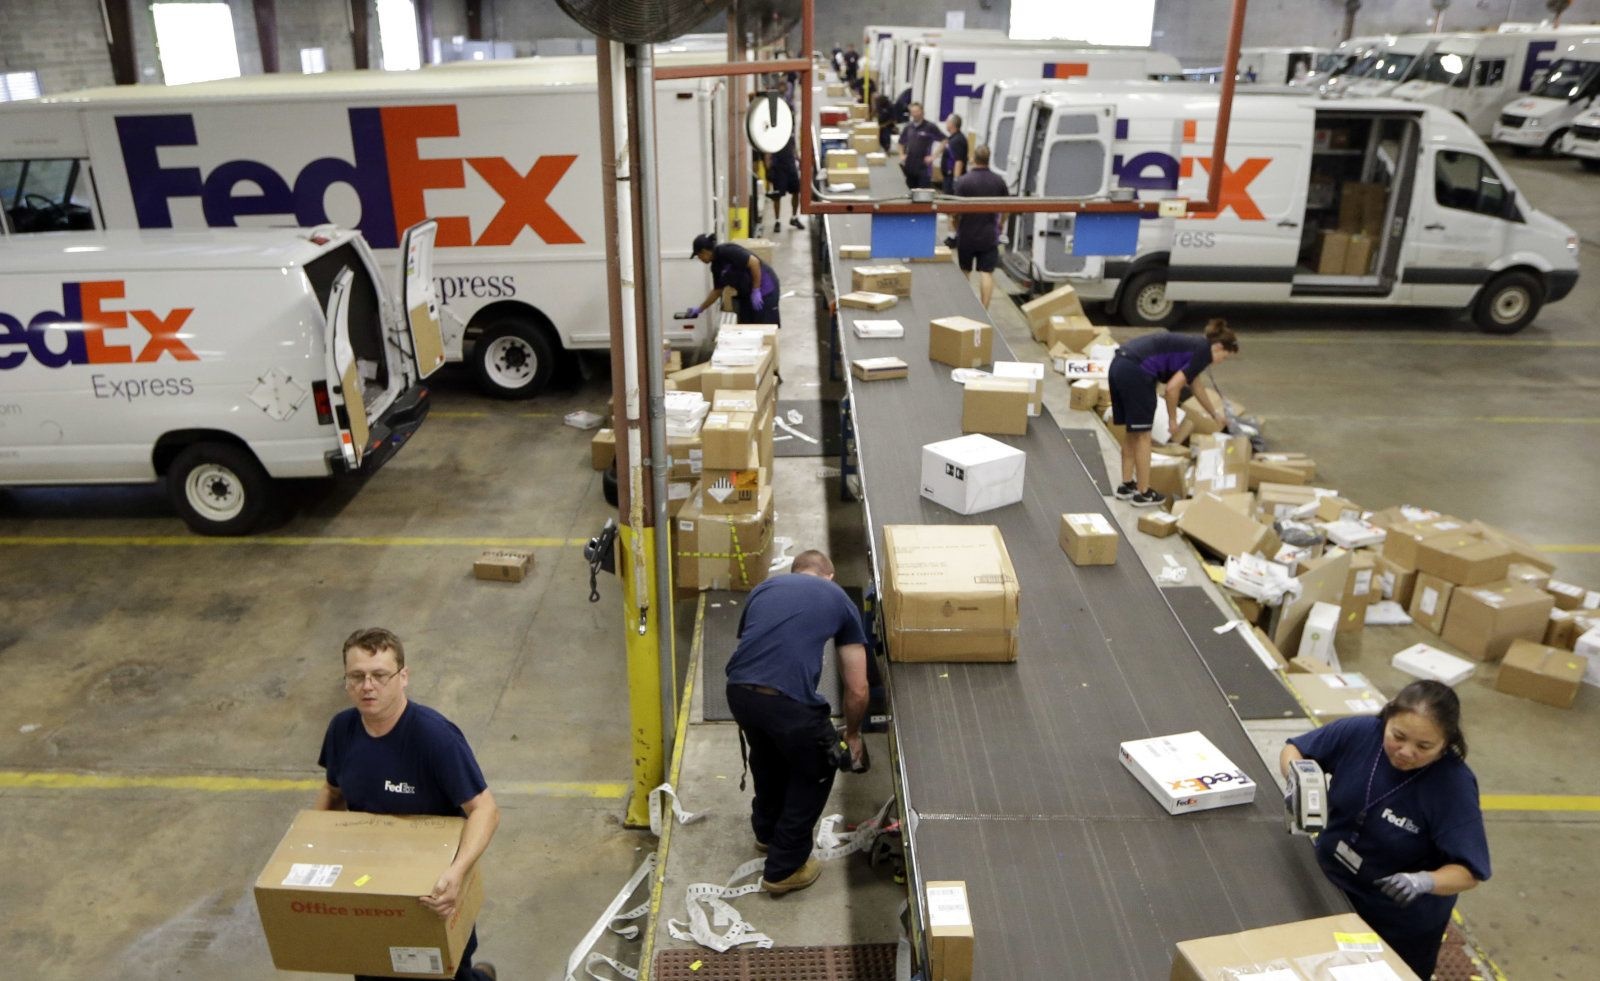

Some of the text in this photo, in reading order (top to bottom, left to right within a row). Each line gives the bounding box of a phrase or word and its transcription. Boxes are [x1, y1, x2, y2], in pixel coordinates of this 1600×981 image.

[114, 104, 586, 249] FedEx
[433, 275, 516, 305] press
[0, 280, 201, 370] edEx
[1068, 362, 1106, 373] FedEx
[91, 374, 194, 402] Express
[384, 780, 415, 794] FedEx
[1381, 807, 1420, 834] FedEx
[290, 901, 406, 918] Office DEPOT
